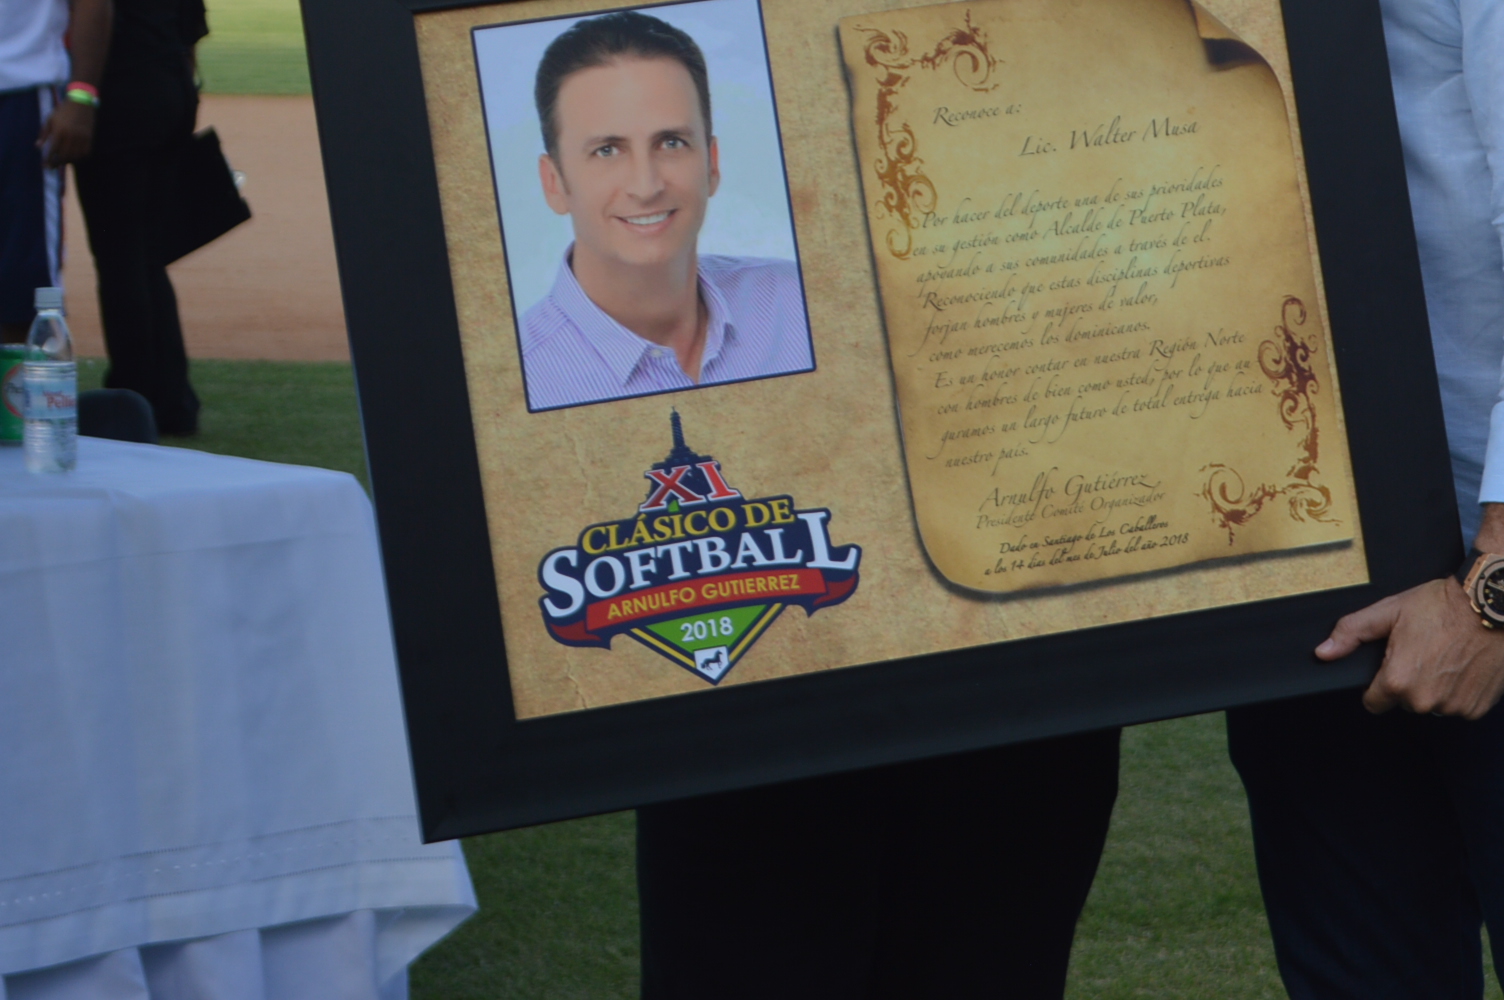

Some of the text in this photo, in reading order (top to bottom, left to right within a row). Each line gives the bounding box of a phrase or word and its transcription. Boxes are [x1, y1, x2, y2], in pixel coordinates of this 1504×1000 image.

[933, 106, 999, 127] Reconoce
[1018, 114, 1198, 156] Lic. Walter Musa
[922, 164, 1223, 229] Por hacer del deporte una de sus prioridades
[912, 193, 1227, 269] en su gestión como Alcalde de Puerto Plata,
[916, 251, 982, 298] apoyando
[985, 262, 994, 273] a
[999, 260, 1020, 271] sus
[1025, 233, 1108, 268] comunidades
[1113, 244, 1122, 255] a
[1129, 233, 1168, 253] través
[1172, 221, 1191, 247] de
[922, 249, 1231, 312] Reconociendo que estas disciplinas deportivas
[906, 311, 969, 357] forjan
[973, 300, 1026, 329] hombres
[1044, 301, 1093, 328] mujeres
[1098, 285, 1117, 311] de
[928, 316, 1150, 363] como merecemos los dominicanos.
[934, 328, 1246, 389] Es un honor contar en nuestra Región Norte
[937, 403, 960, 415] con
[965, 381, 1018, 411] hombres
[1022, 376, 1042, 403] de
[1044, 373, 1072, 399] bien
[1077, 379, 1112, 394] como
[1154, 368, 1184, 398] por
[1188, 352, 1203, 377] lo
[1203, 360, 1230, 390] que
[925, 371, 1263, 460] guramos un largo futuro de total entrega hacia
[944, 449, 993, 468] nuestro
[639, 460, 742, 512] XI
[976, 488, 1166, 529] Presidente Comité Organizador
[978, 466, 1162, 513] Arnulfo Gutiérrez
[581, 498, 796, 555] CLÁSICO DE
[999, 514, 1169, 554] Dado en Santiago de Los Caballeros
[541, 511, 859, 618] SOFTBALL
[983, 567, 992, 576] a
[994, 558, 1007, 574] los
[1010, 559, 1025, 571] 14
[1048, 548, 1064, 566] del
[1065, 553, 1081, 563] mes
[1083, 543, 1095, 561] de
[1094, 539, 1121, 560] Julio
[1123, 535, 1140, 554] del
[1159, 532, 1190, 548] 2018
[606, 573, 801, 621] ARNULFO GUTIERREZ
[679, 616, 734, 643] 2018
